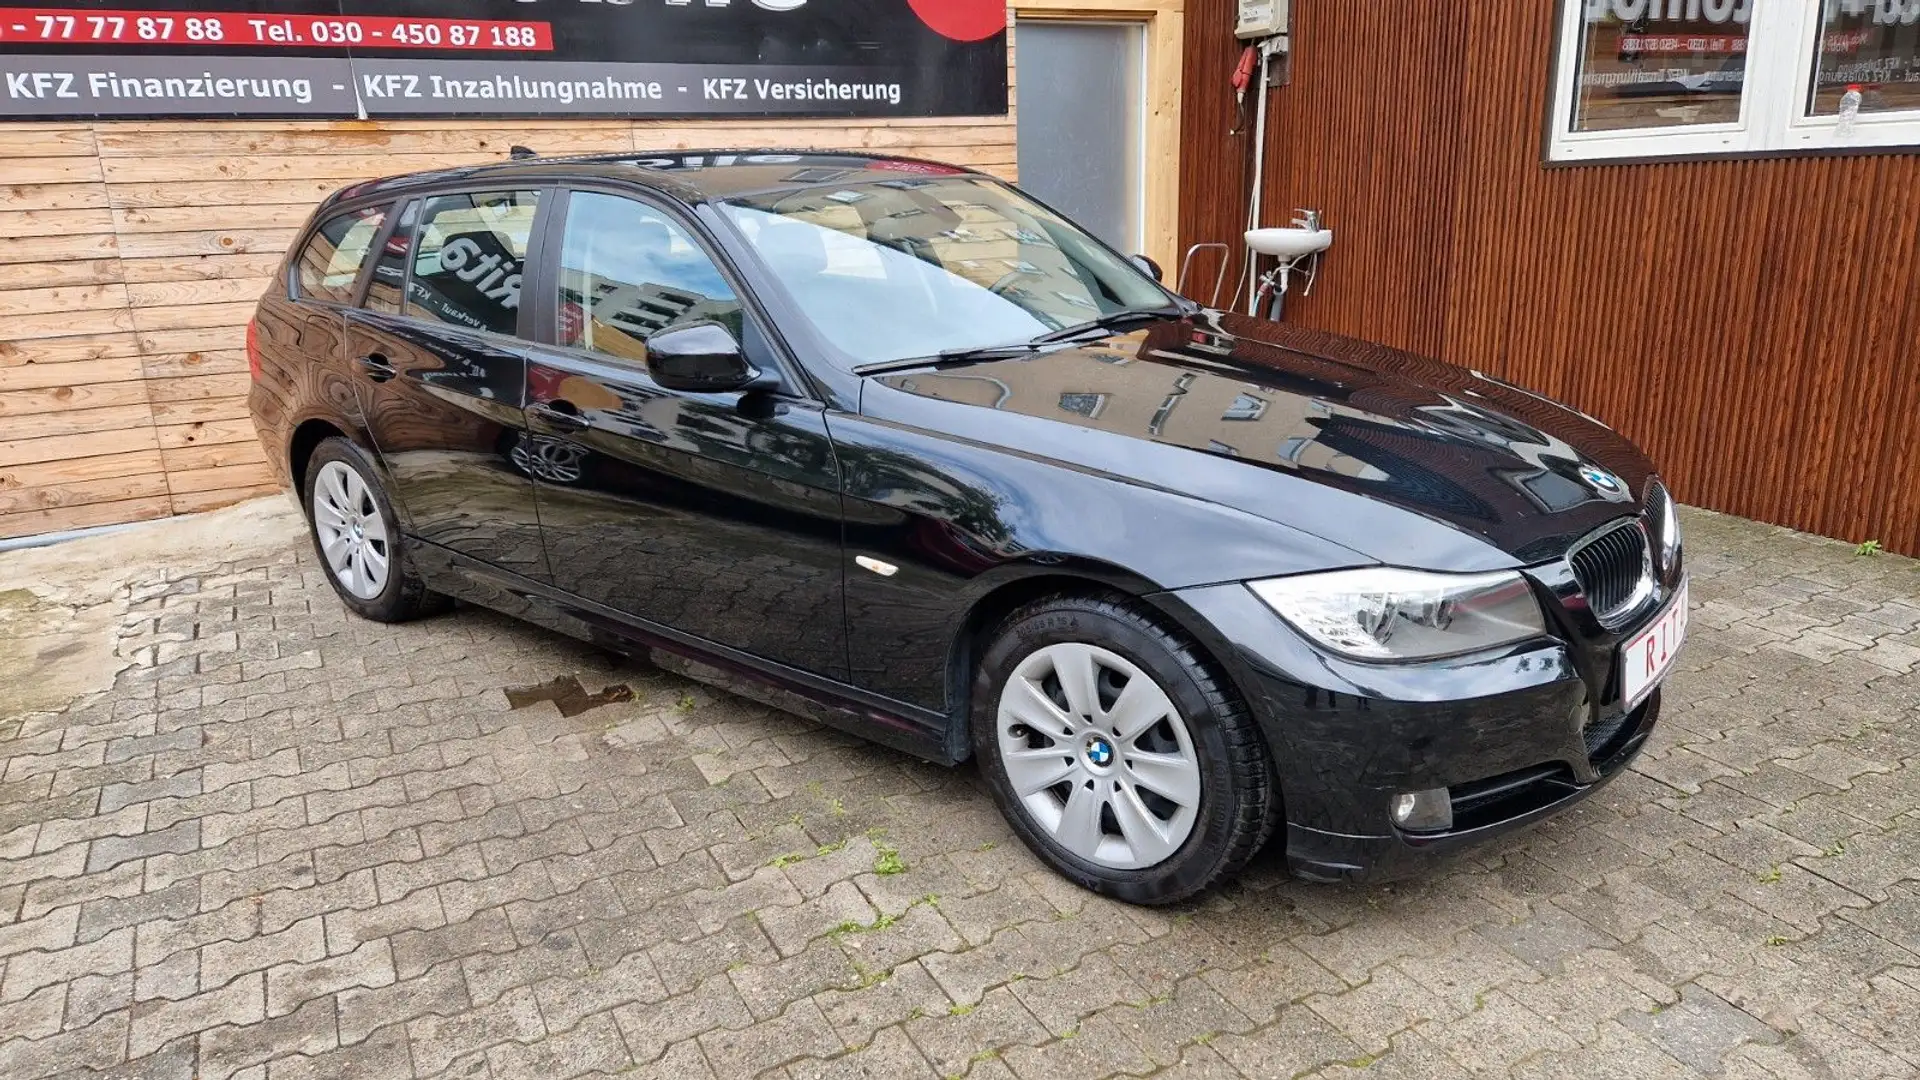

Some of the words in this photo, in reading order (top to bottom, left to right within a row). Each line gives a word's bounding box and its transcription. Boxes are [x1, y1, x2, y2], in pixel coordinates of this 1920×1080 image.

[35, 15, 76, 39] 77
[86, 16, 125, 39] 77
[136, 17, 174, 40] 87
[185, 17, 224, 41] 88
[249, 19, 303, 42] Tel.
[311, 21, 363, 43] 030
[391, 23, 442, 45] 450
[449, 25, 480, 46] 87
[490, 26, 537, 47] 188
[6, 72, 79, 99] KFZ
[88, 71, 312, 104] Finanzierung
[364, 74, 422, 98] KFZ
[431, 75, 663, 104] Inzahlungnahme
[703, 78, 748, 100] KFZ
[753, 79, 901, 104] Versicherung
